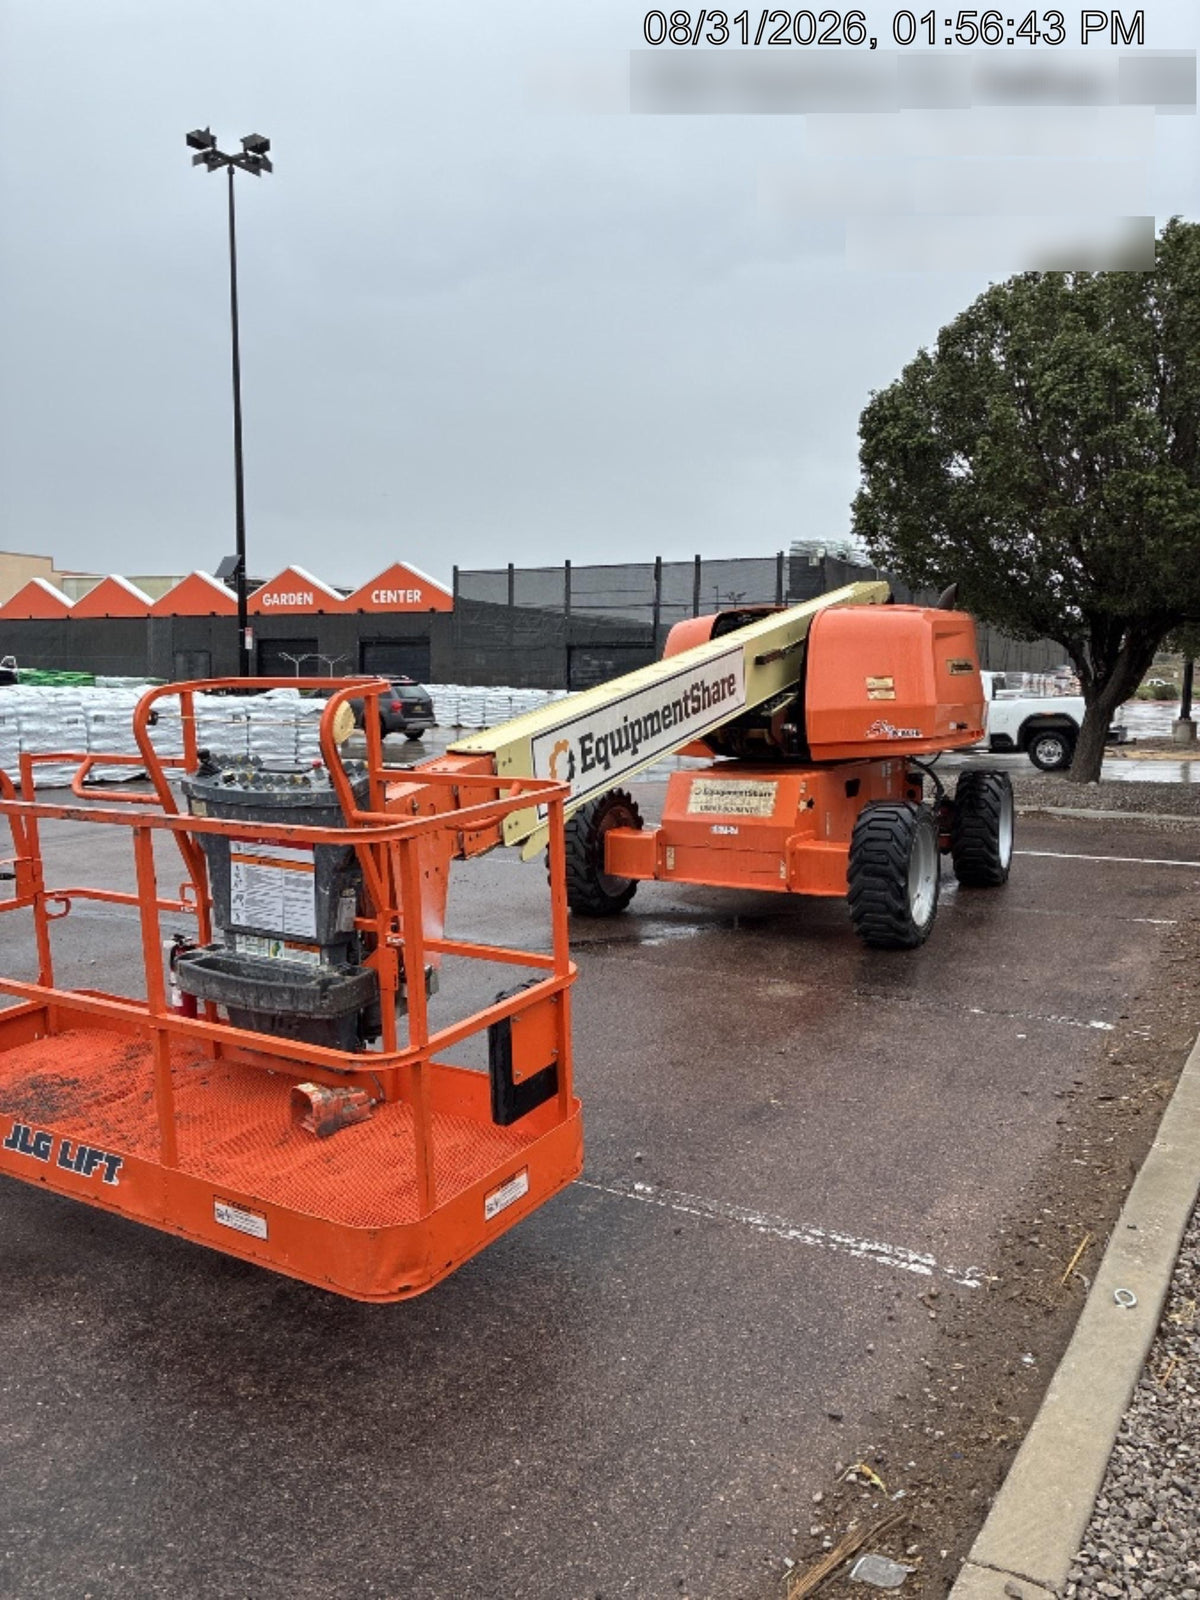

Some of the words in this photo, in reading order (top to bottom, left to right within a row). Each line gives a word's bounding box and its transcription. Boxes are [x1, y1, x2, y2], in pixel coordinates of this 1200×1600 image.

[262, 592, 314, 606] GARDEN
[371, 589, 422, 604] CENTER
[578, 673, 736, 774] EquipmentShare
[3, 1123, 54, 1163] JLG
[56, 1139, 124, 1184] LIFT
